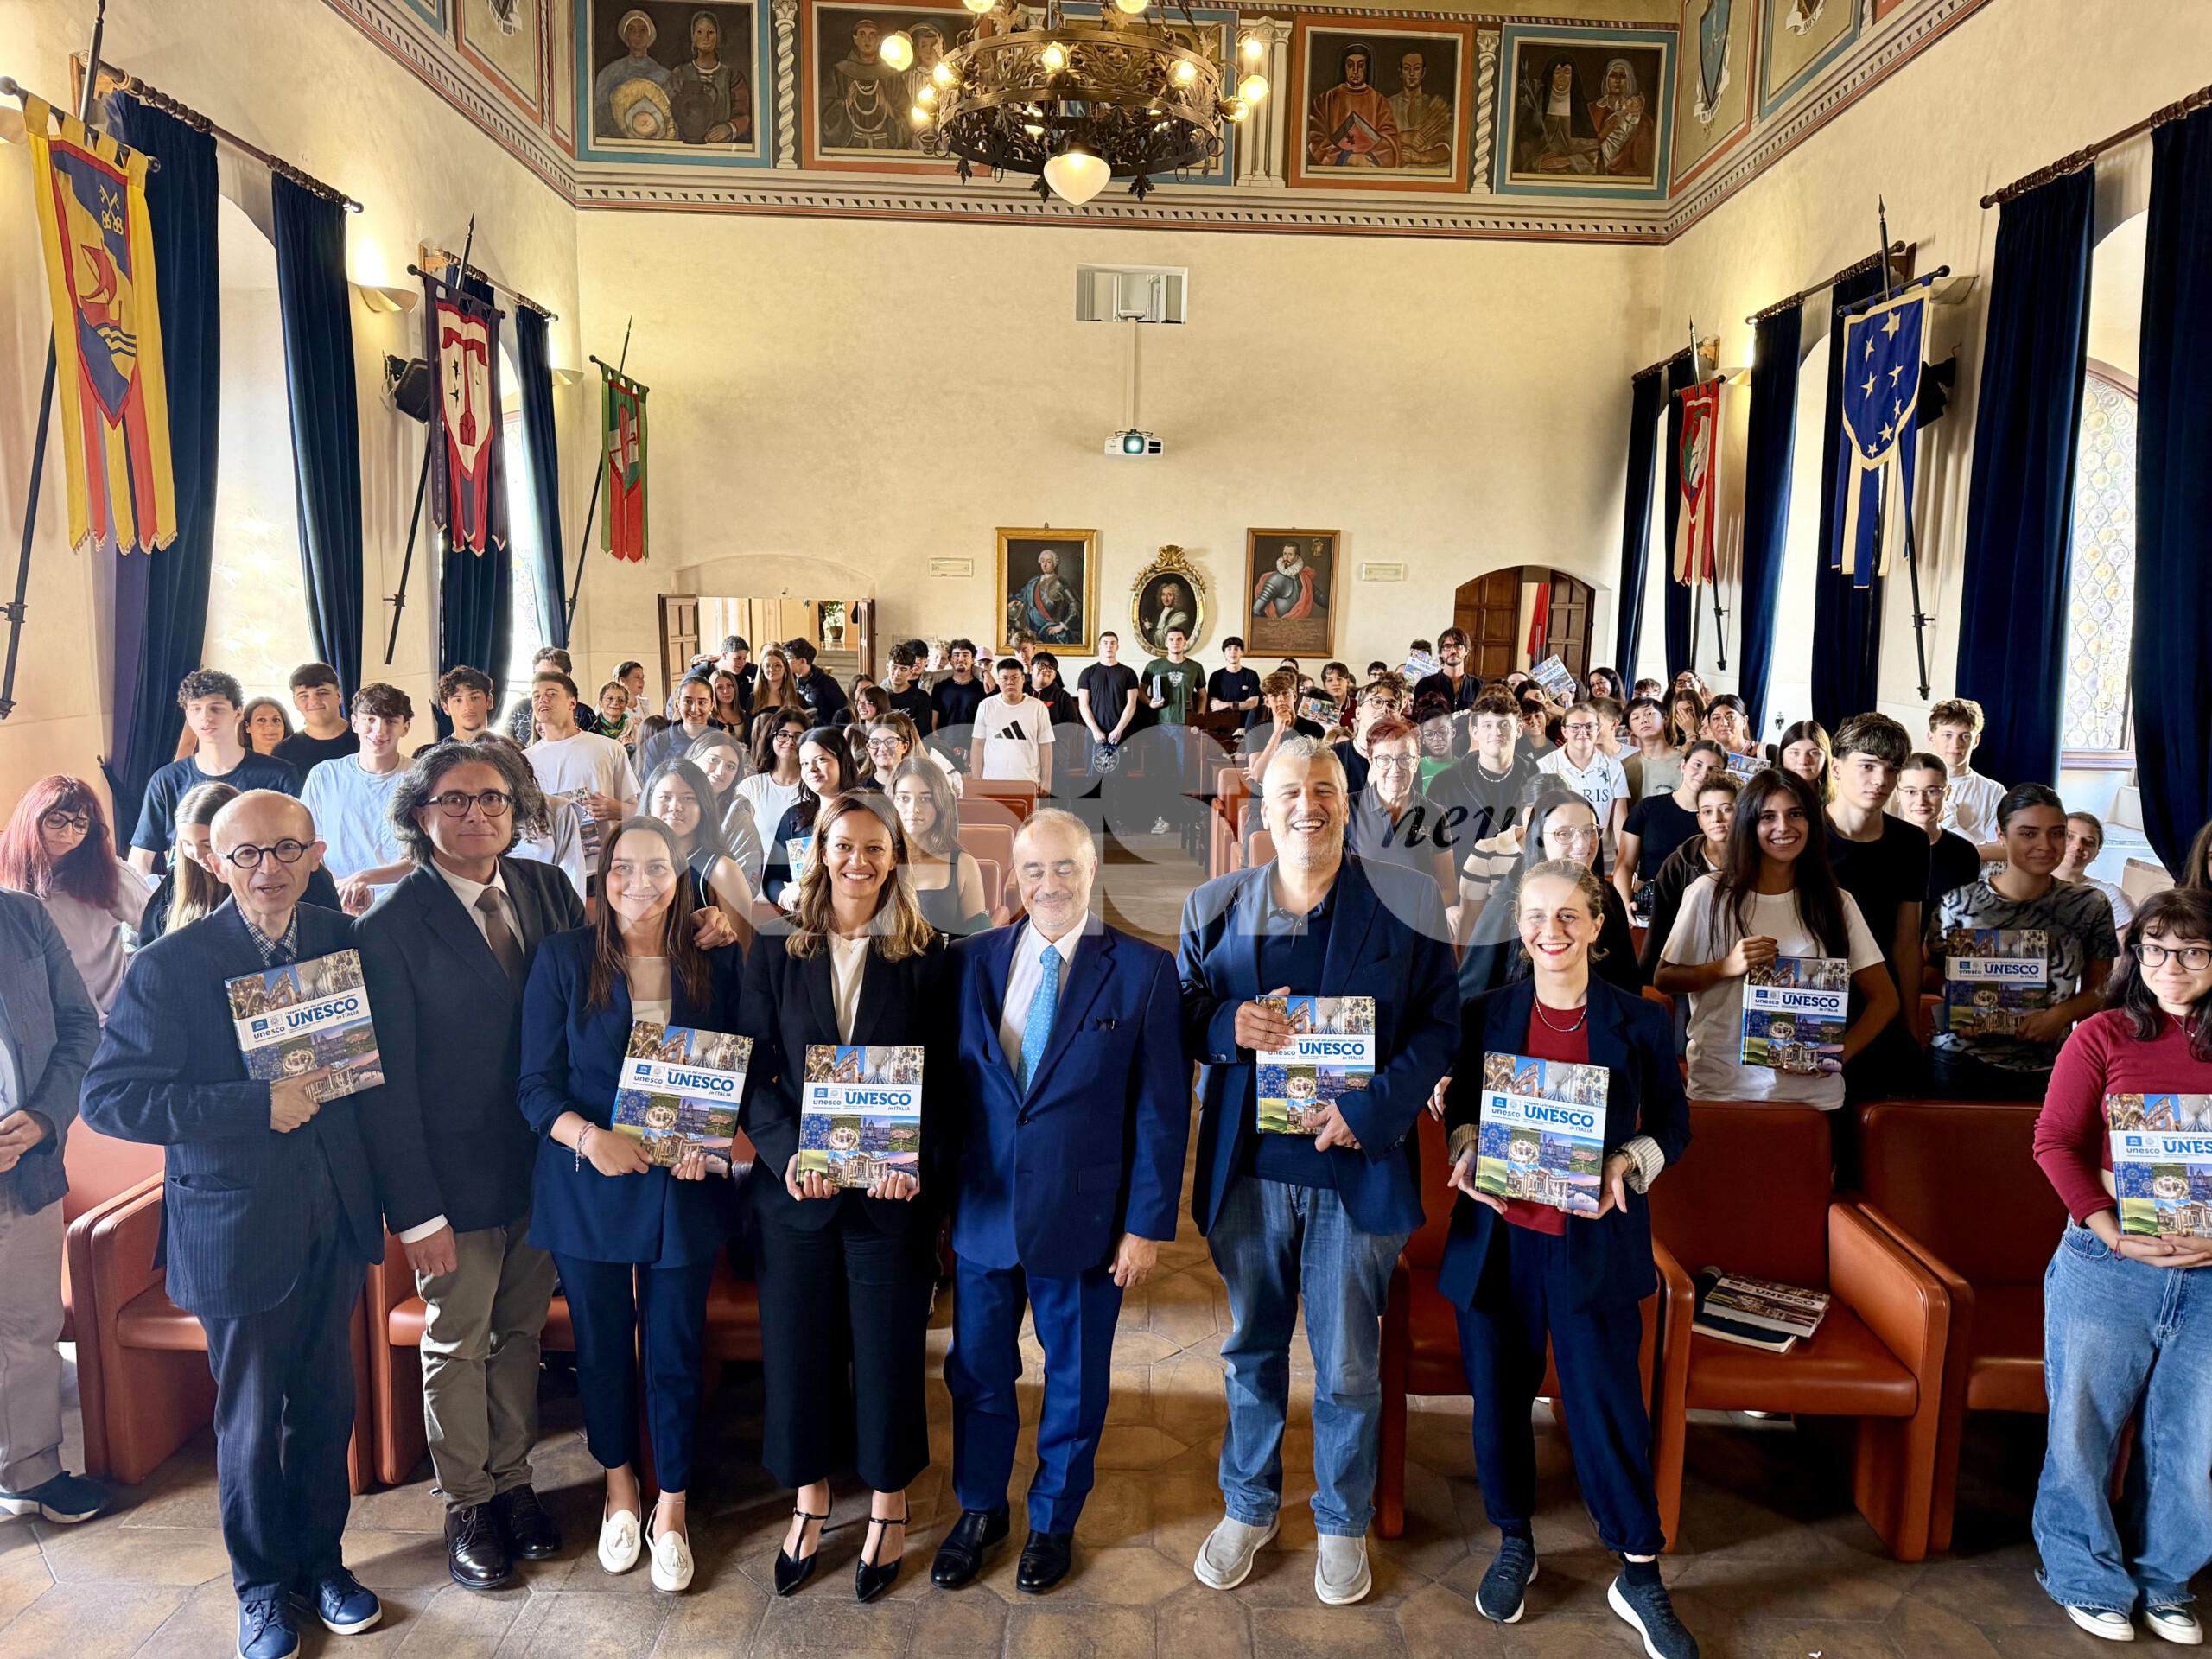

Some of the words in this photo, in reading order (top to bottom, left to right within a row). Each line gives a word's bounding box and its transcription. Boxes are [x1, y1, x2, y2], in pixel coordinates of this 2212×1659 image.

[1985, 964, 2039, 975] UNESCO
[1782, 995, 1840, 1008] UNESCO
[286, 998, 359, 1027] UNESCO
[253, 1026, 286, 1039] unesco
[1299, 1043, 1364, 1055] UNESCO
[633, 1075, 664, 1084] unesco
[667, 1071, 734, 1092] UNESCO
[845, 1091, 912, 1106] UNESCO
[1491, 1108, 1521, 1118] unesco
[1523, 1105, 1594, 1128] UNESCO
[2163, 1140, 2212, 1154] UNES
[1756, 1287, 1815, 1306] UNESCO
